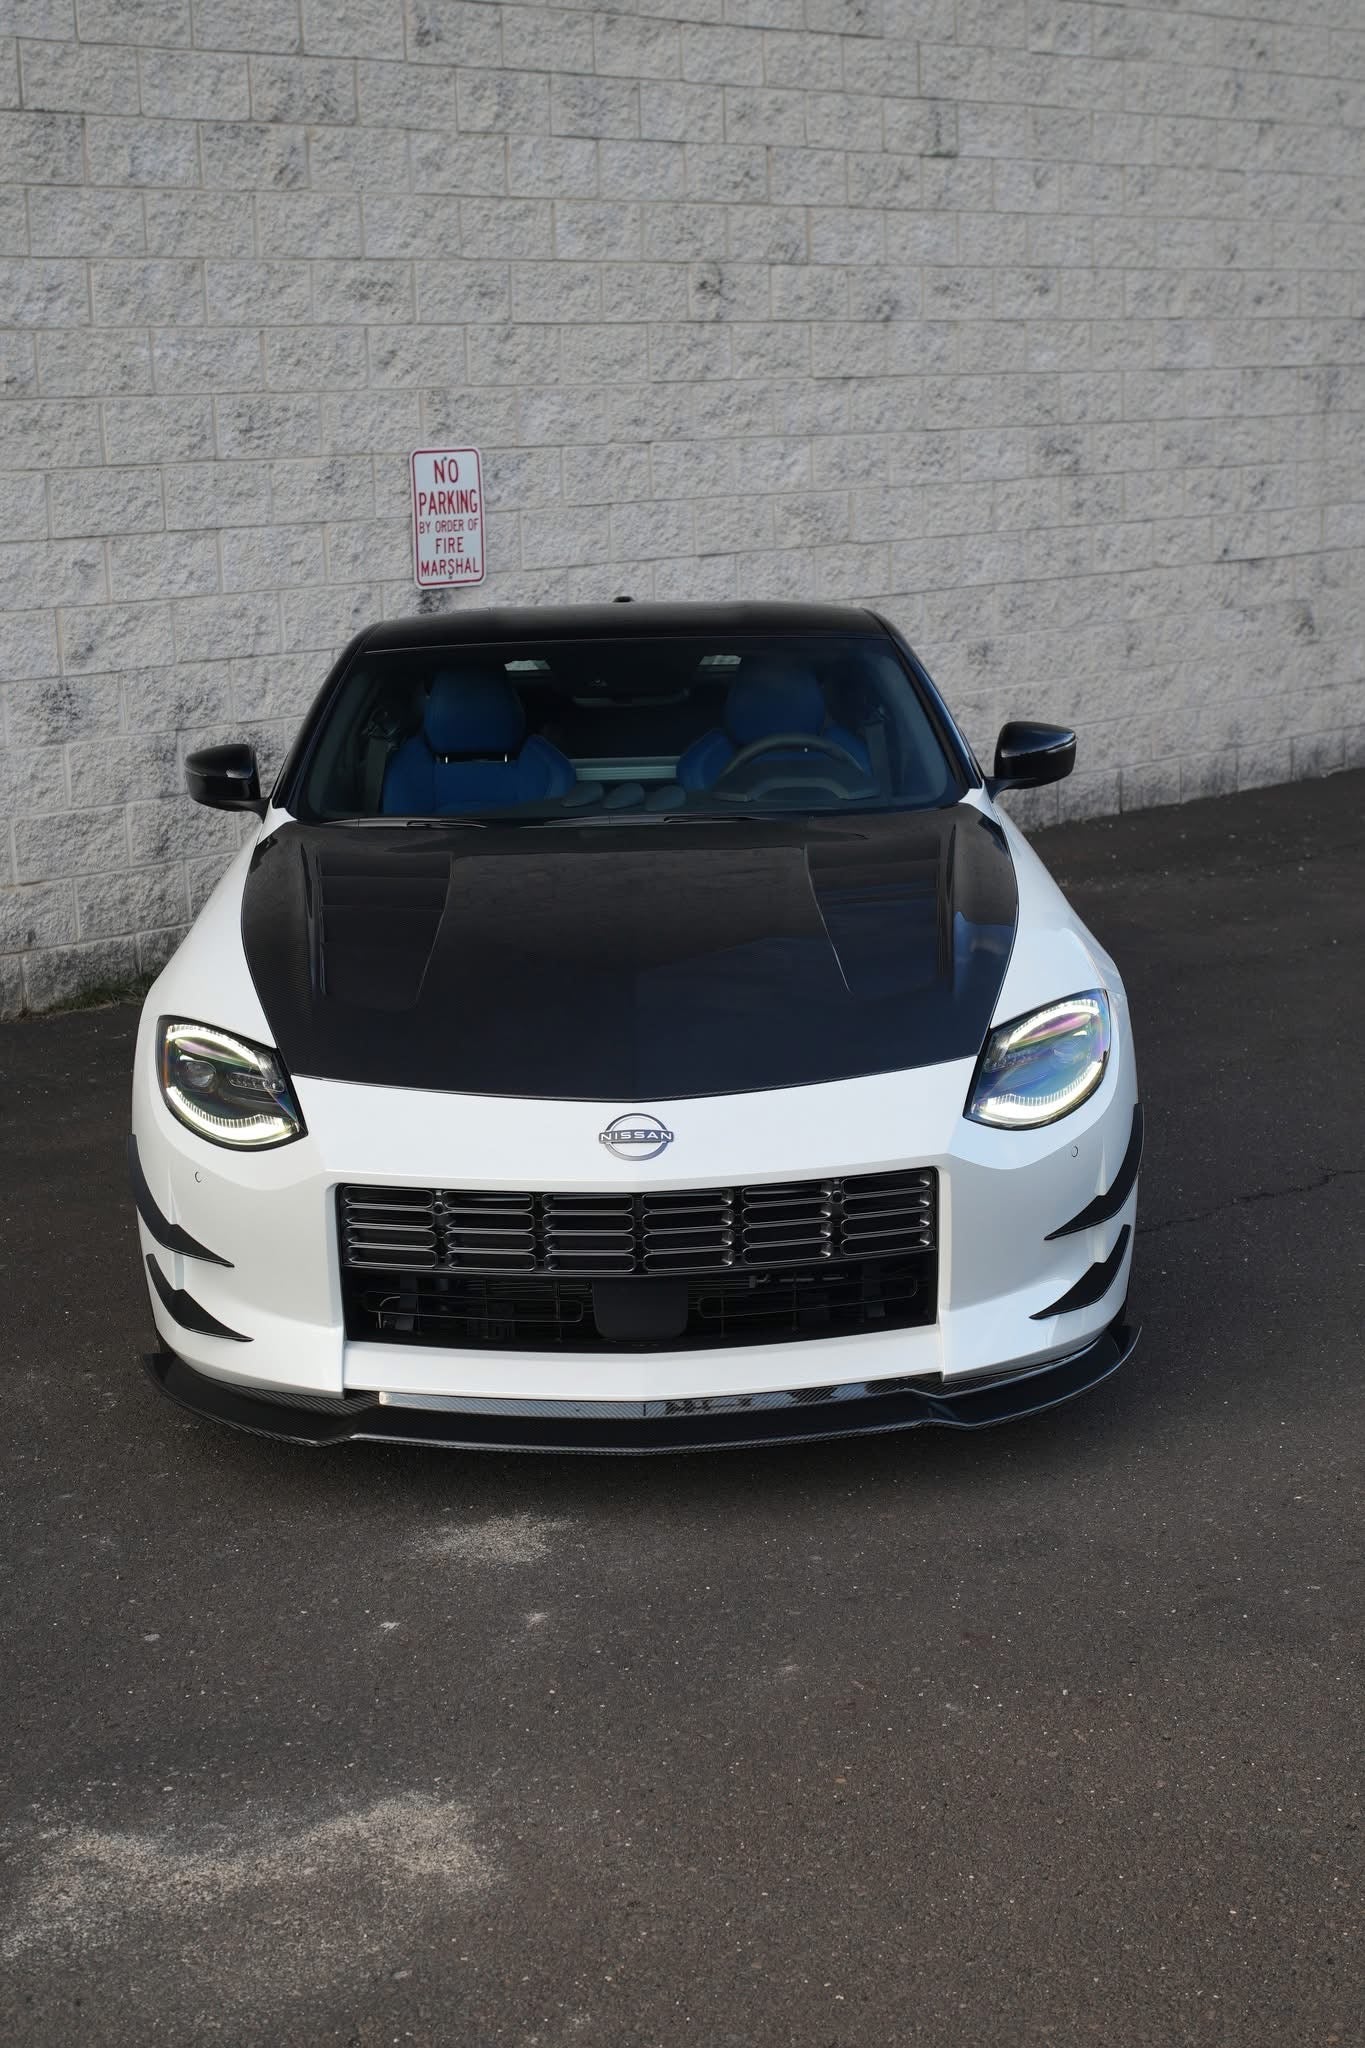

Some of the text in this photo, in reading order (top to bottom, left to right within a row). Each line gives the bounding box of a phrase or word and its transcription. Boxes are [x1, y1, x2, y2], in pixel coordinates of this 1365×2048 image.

[434, 459, 459, 484] NO
[419, 489, 478, 516] PARKING
[419, 518, 479, 534] BY ORDER OF
[435, 537, 464, 554] FIRE
[421, 557, 480, 577] MARSHAL
[601, 1131, 672, 1141] NISSAN
